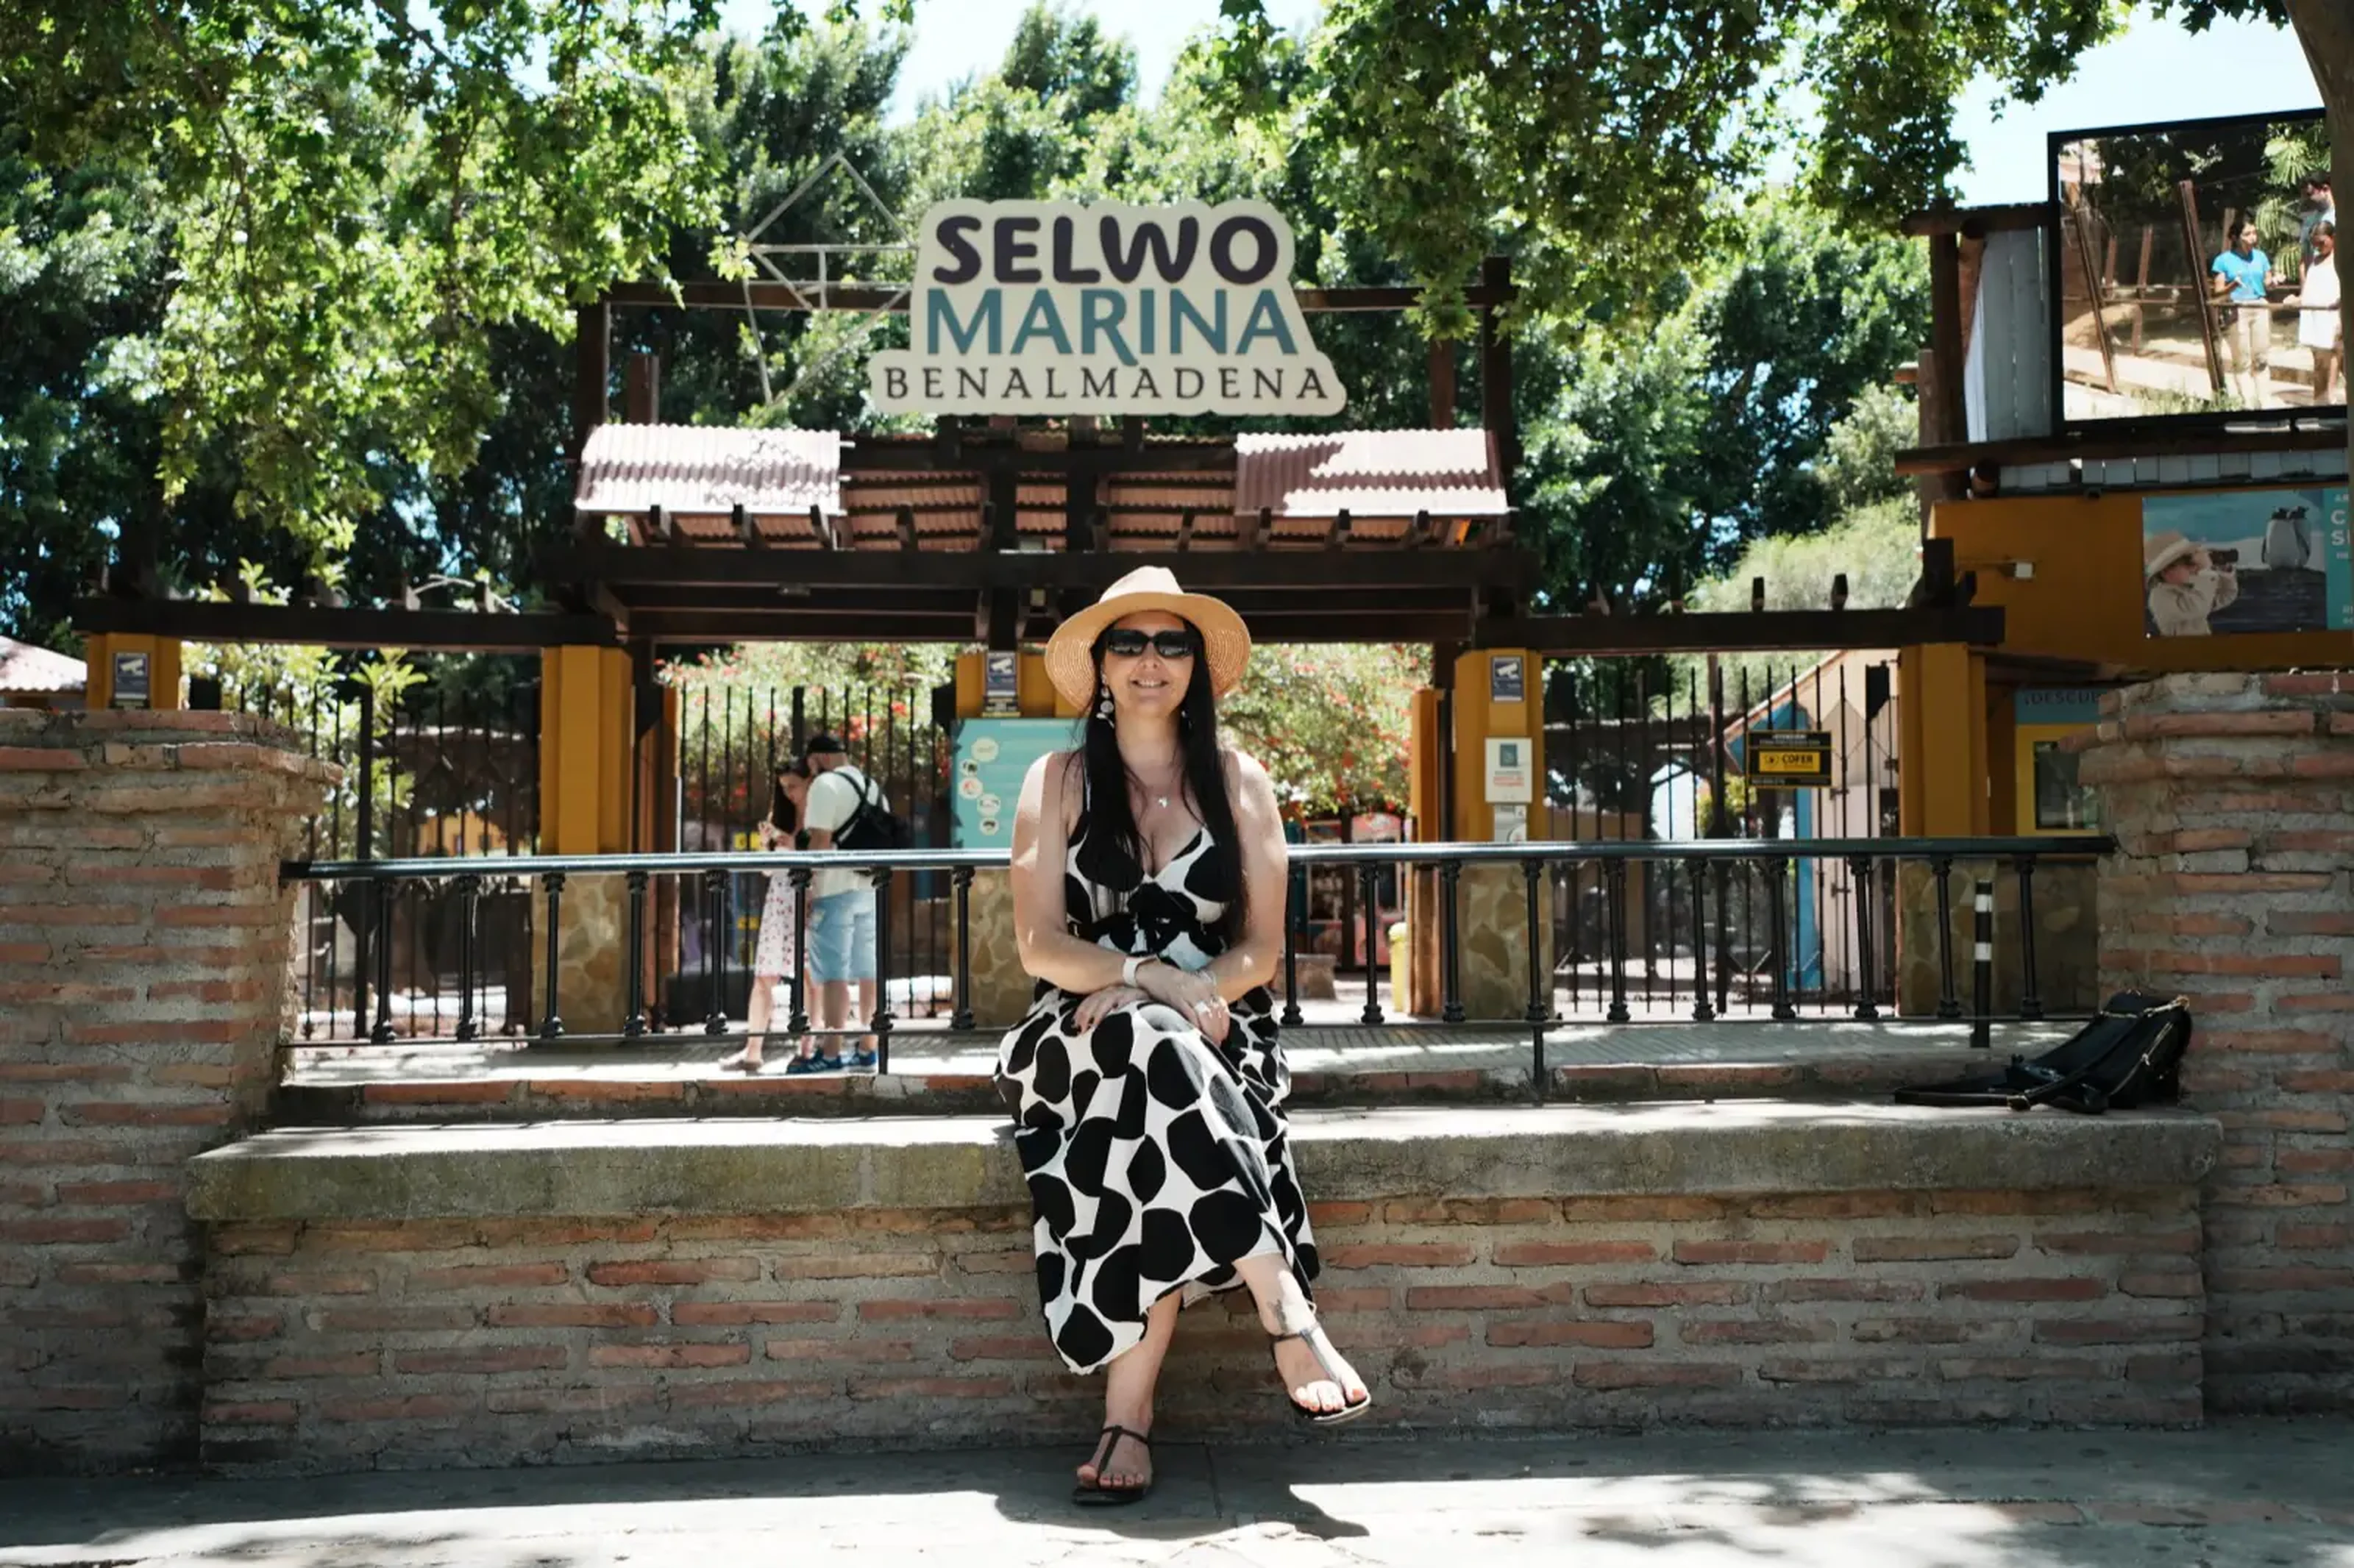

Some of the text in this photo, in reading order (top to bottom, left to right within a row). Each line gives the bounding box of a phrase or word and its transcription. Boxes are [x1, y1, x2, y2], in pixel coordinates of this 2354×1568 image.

[933, 215, 1279, 285] SELWO
[927, 288, 1299, 367] MARINA
[884, 366, 1329, 400] BENALMADENA
